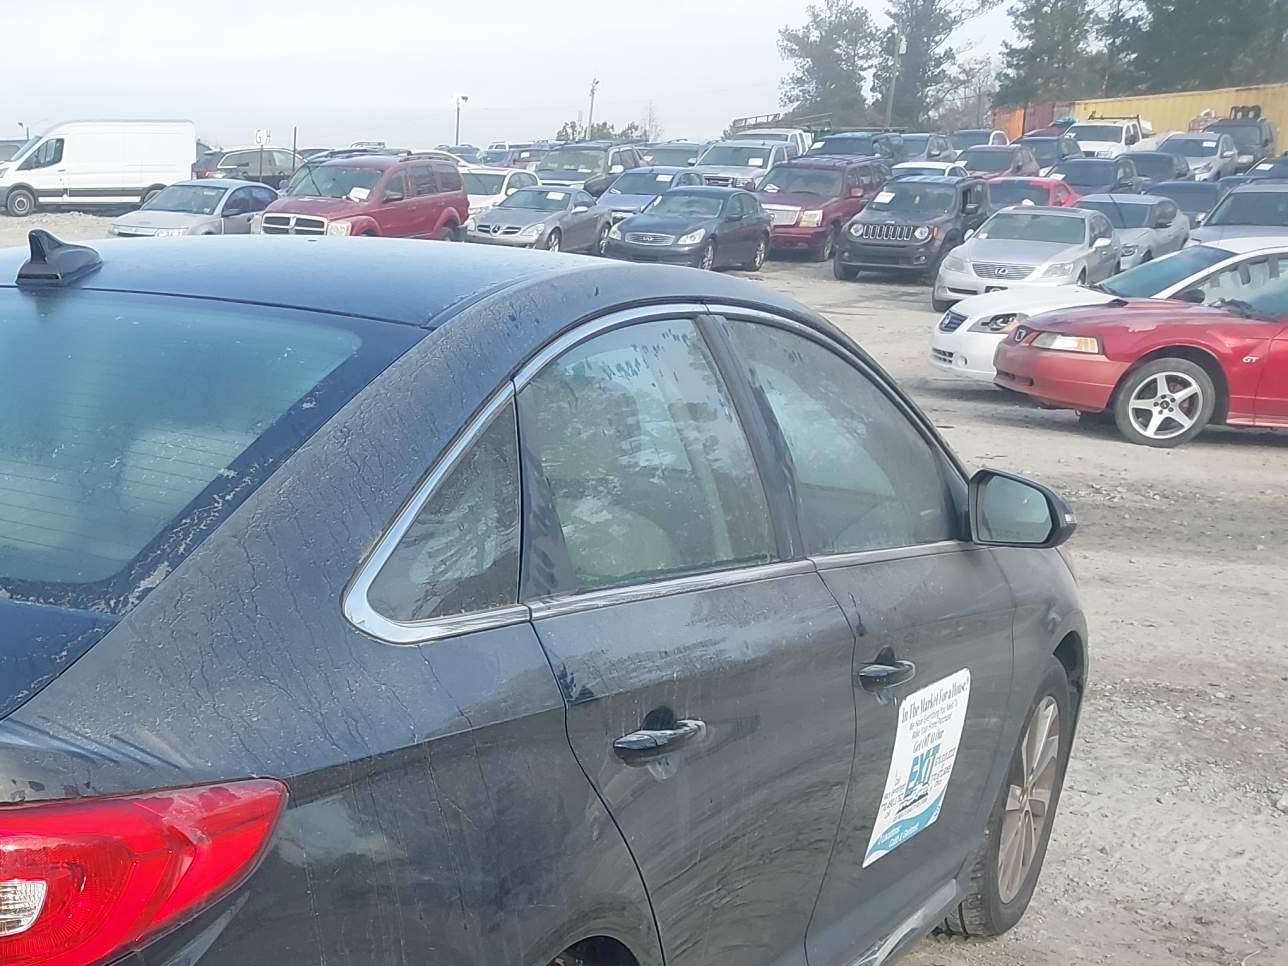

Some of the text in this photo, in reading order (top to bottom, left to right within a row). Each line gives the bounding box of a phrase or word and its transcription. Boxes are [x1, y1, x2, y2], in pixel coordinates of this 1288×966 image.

[1242, 355, 1260, 363] GT
[910, 701, 920, 719] The
[905, 744, 941, 797] EXIT
